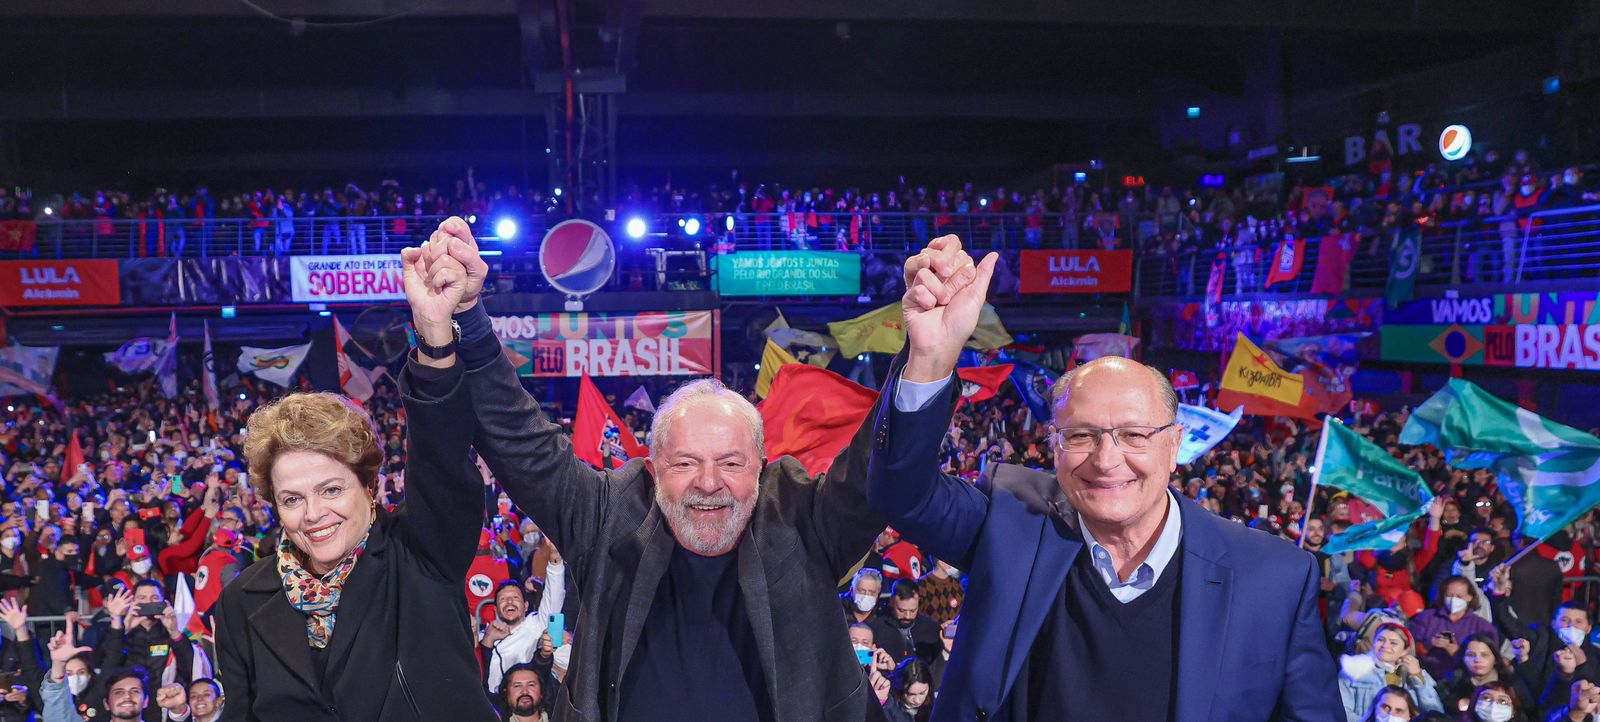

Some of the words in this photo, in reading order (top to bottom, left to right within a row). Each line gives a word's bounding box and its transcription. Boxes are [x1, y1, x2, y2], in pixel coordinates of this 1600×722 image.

[1344, 123, 1423, 166] BAR
[308, 261, 341, 271] GRANDE
[344, 261, 360, 270] ATO
[362, 260, 375, 270] EM
[732, 256, 763, 269] VAMOS
[764, 256, 799, 269] JUNTOS
[798, 257, 804, 268] E
[806, 257, 839, 268] JUNTAS
[1048, 256, 1100, 273] LULA
[19, 266, 81, 284] LULA
[733, 269, 755, 280] PELO
[756, 269, 772, 279] RIO
[772, 269, 806, 279] GRANDE
[808, 269, 821, 279] DO
[822, 269, 838, 279] SUL
[1050, 276, 1098, 287] Alckmin
[762, 281, 783, 290] PELO
[784, 280, 816, 291] BRASIL
[1431, 297, 1492, 323] VAMOS
[538, 311, 688, 340] JUNTOS
[1487, 332, 1515, 361] PELO
[532, 346, 564, 374] PELO
[565, 338, 691, 377] BRASIL
